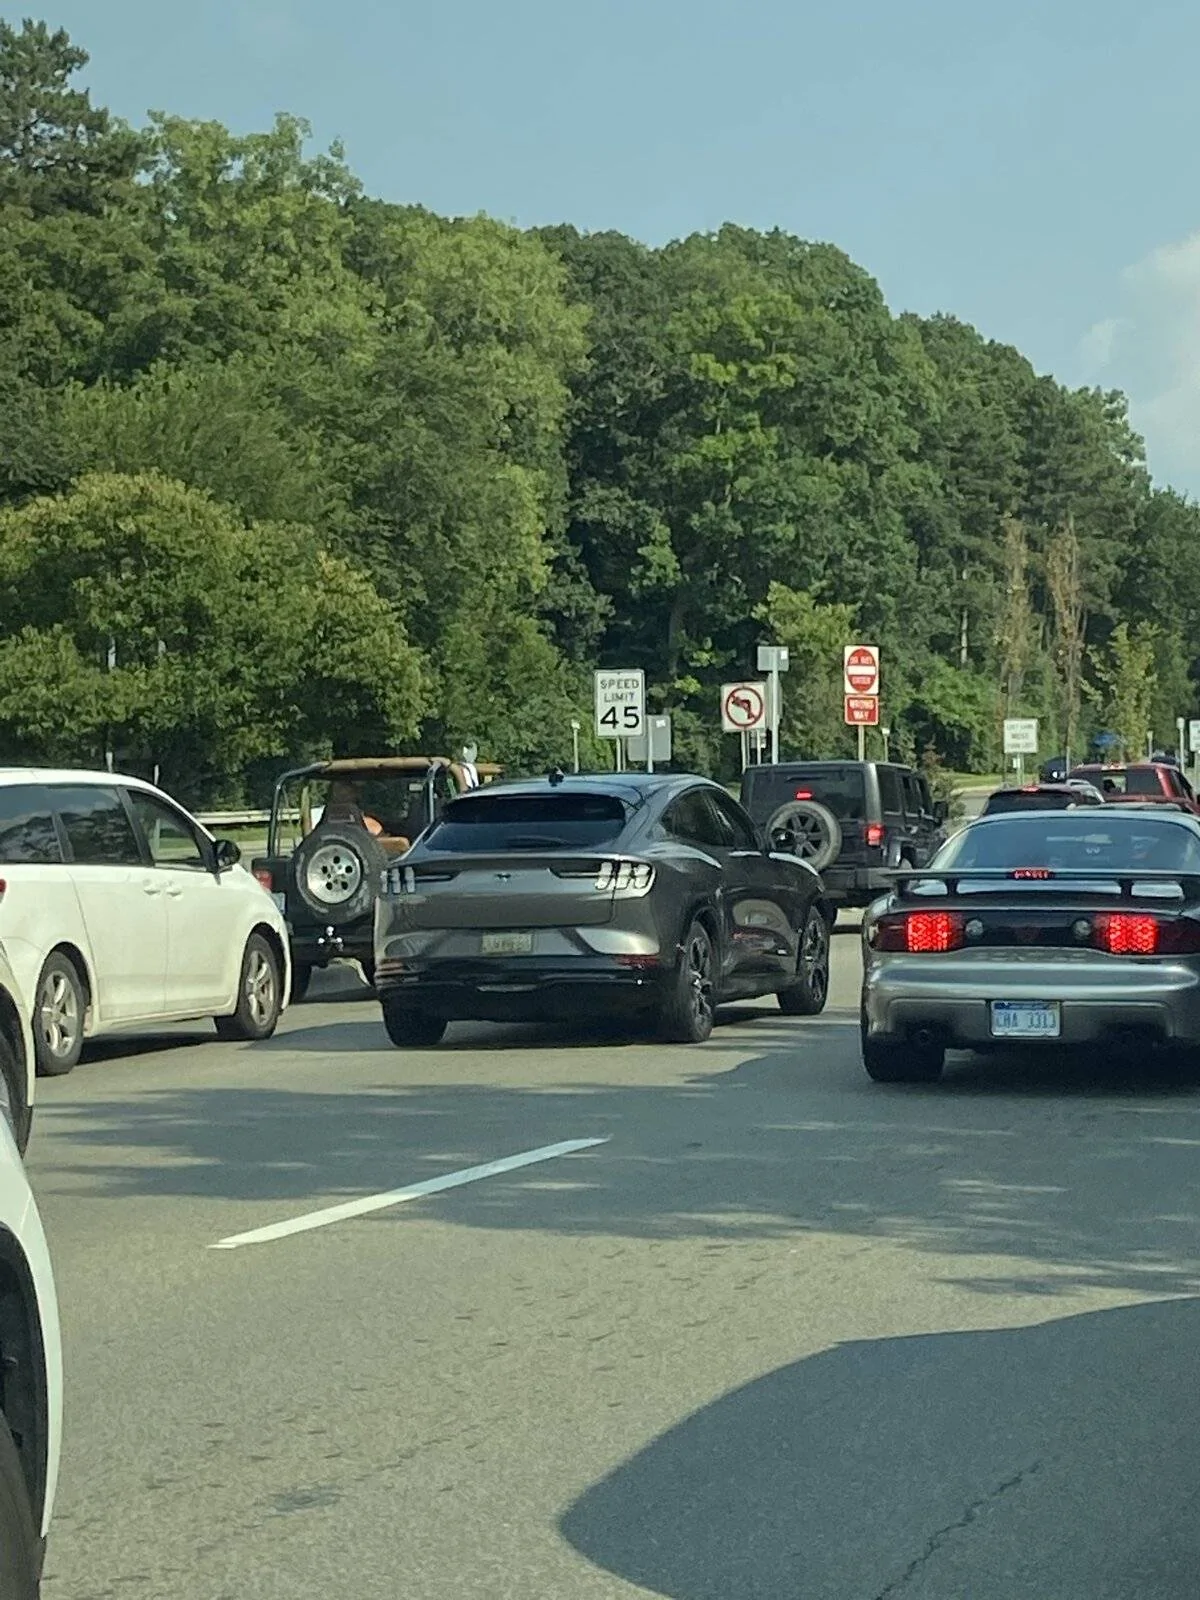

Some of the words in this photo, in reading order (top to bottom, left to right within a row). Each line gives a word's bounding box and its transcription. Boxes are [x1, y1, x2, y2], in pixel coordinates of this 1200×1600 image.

[600, 678, 640, 689] SPEED
[604, 692, 635, 703] LIMIT
[600, 706, 640, 729] 45
[852, 710, 870, 721] WAY
